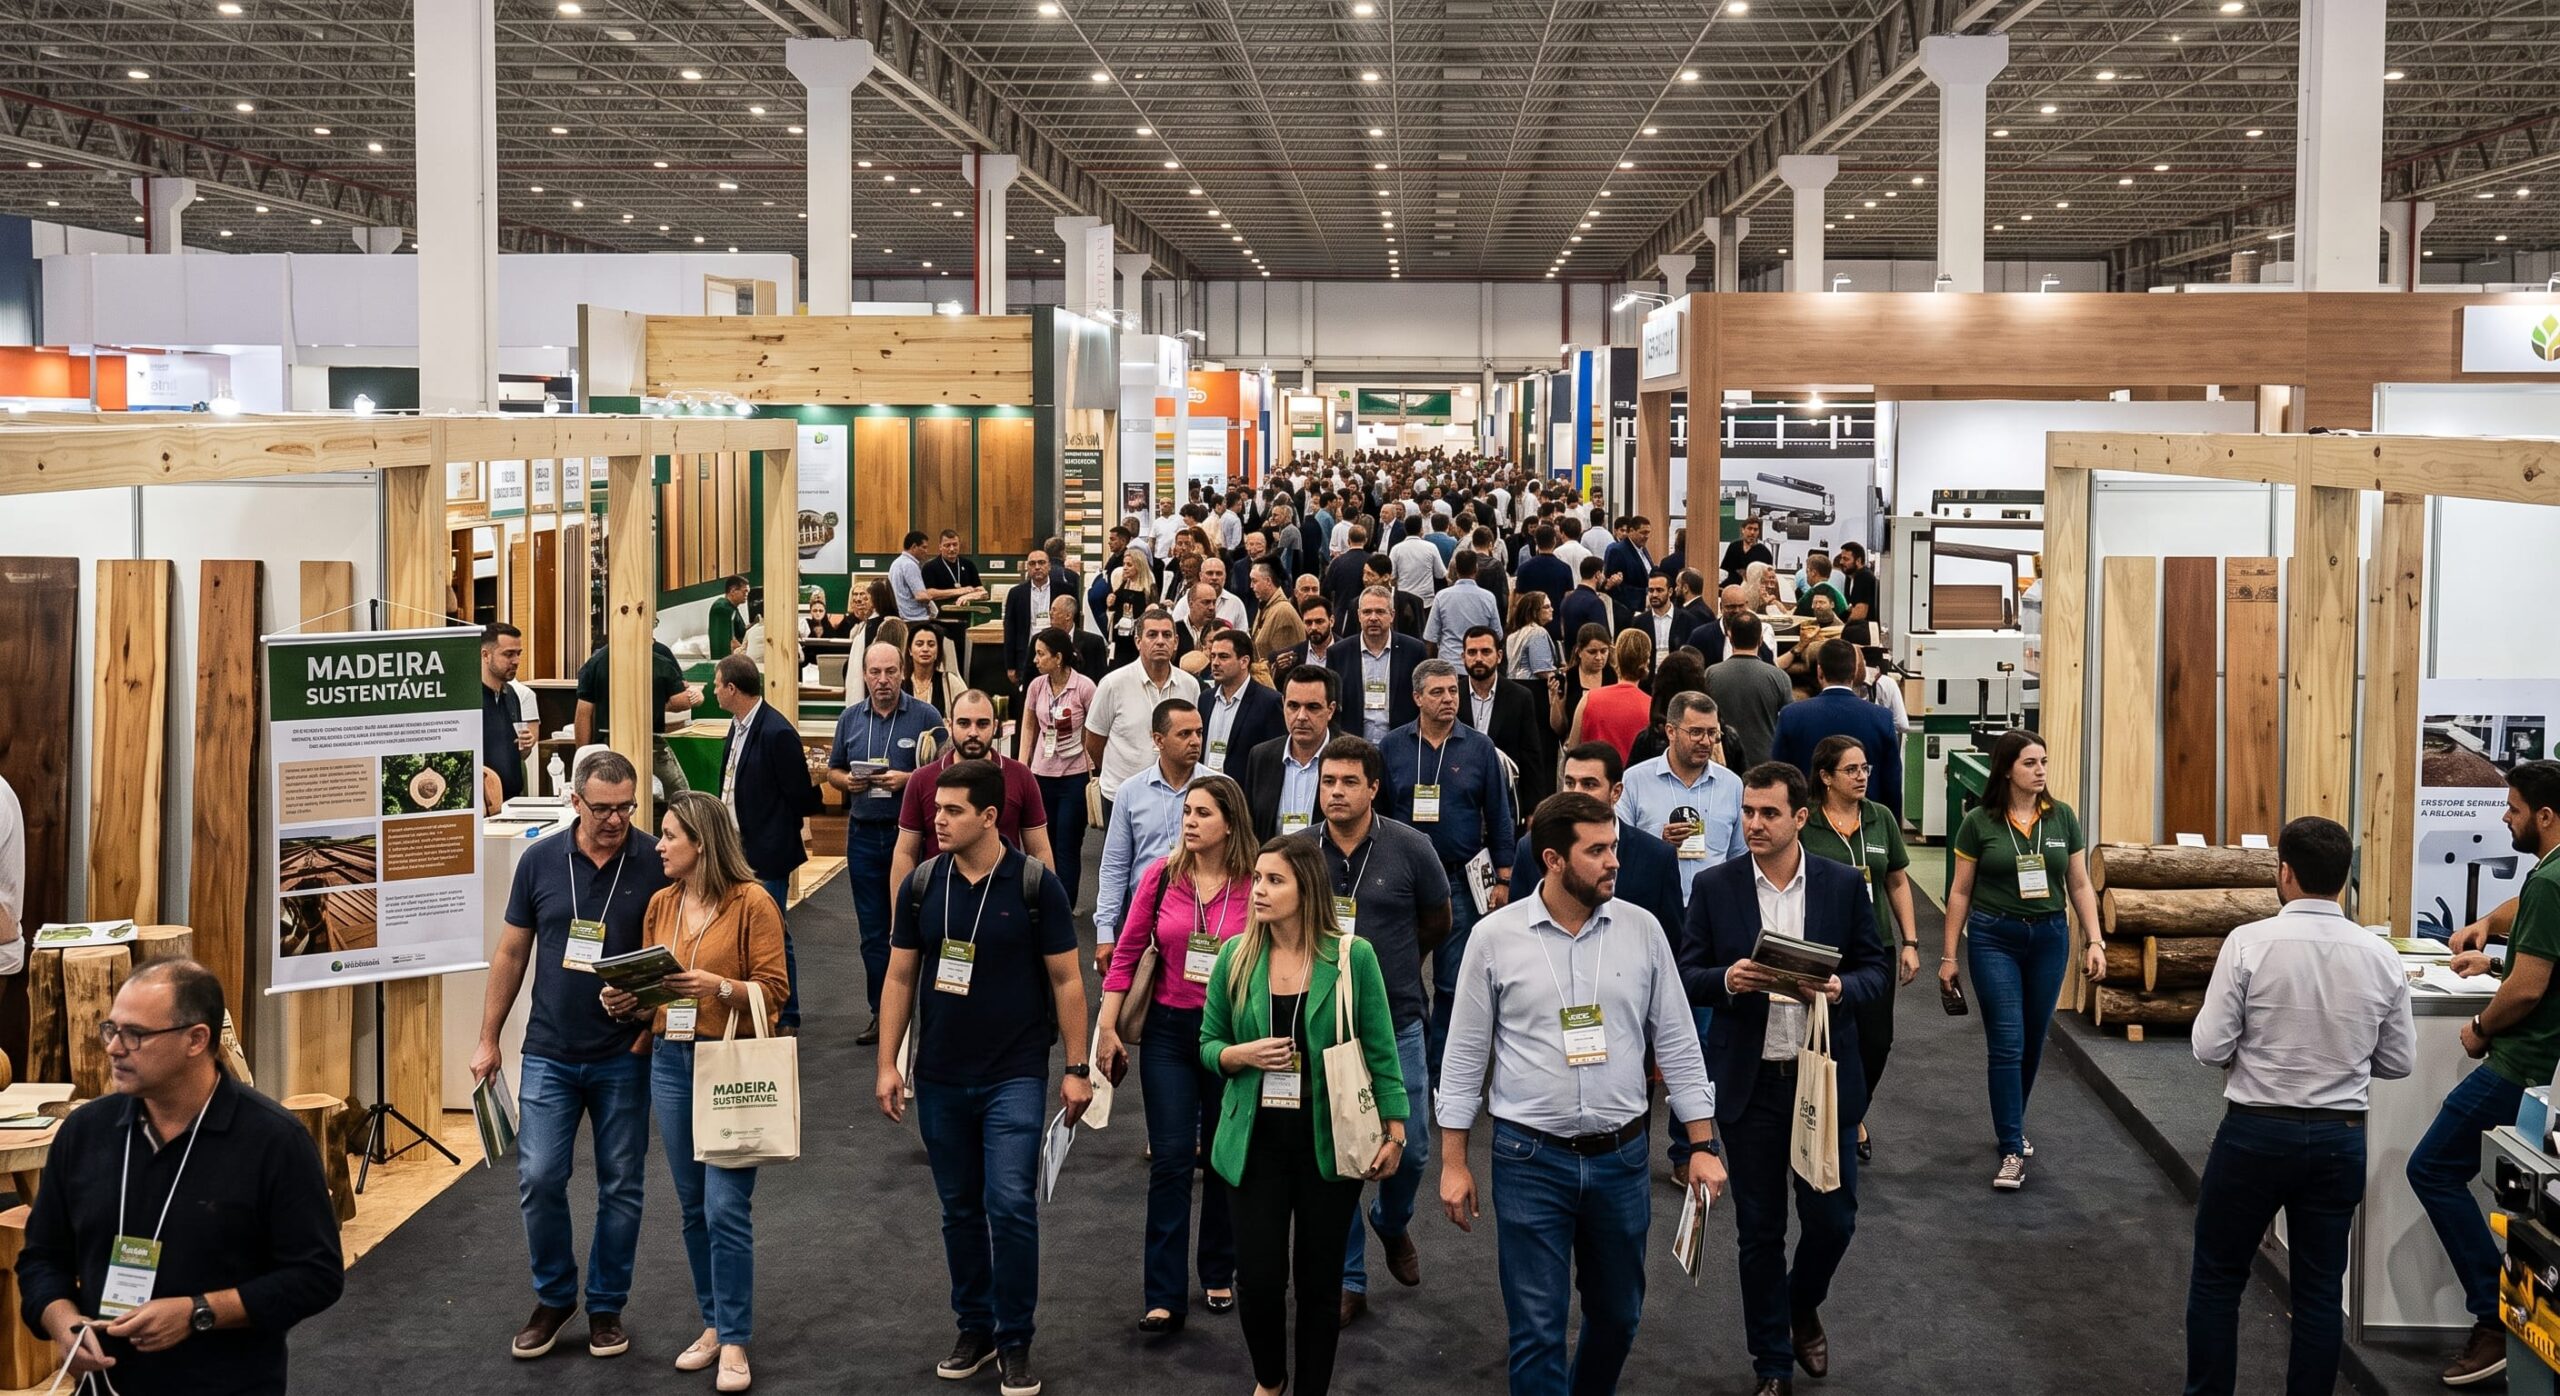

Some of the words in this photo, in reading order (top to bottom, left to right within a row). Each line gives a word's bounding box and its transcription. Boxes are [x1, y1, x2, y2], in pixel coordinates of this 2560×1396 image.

[307, 650, 445, 681] MADEIRA
[306, 678, 447, 705] SUSTENTÁVEL
[713, 1081, 777, 1096] MADEIRA
